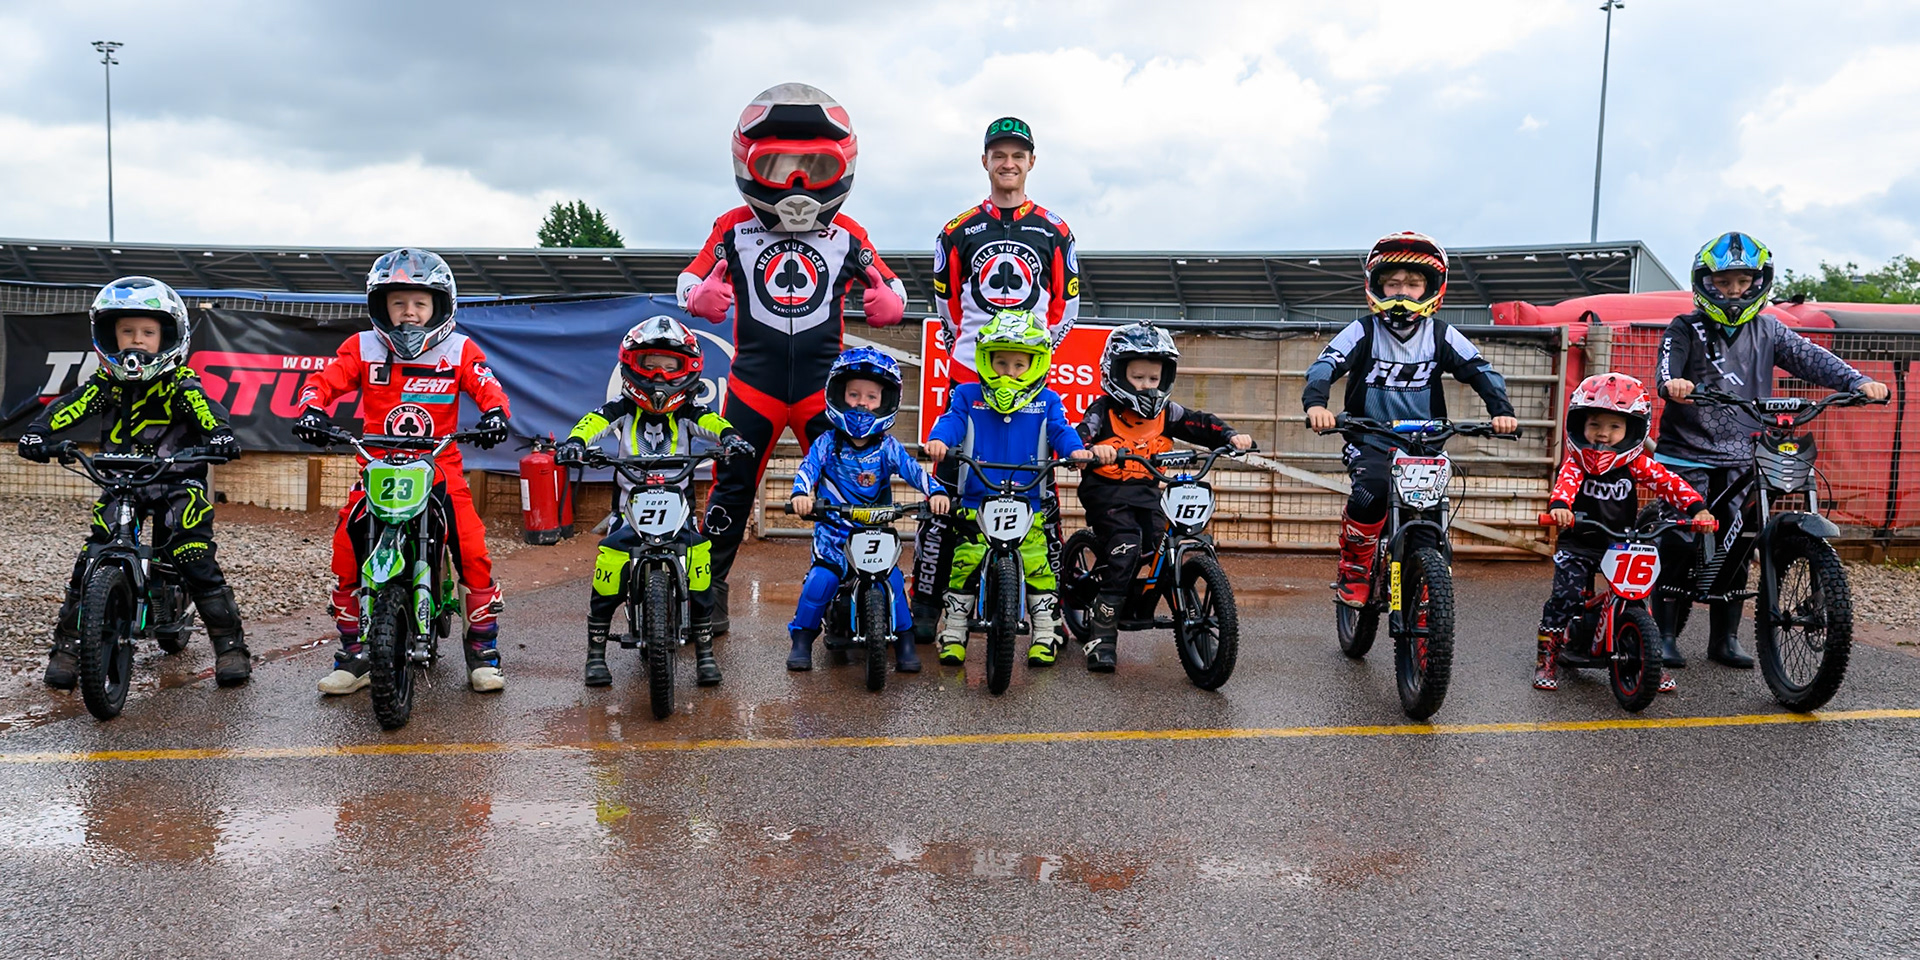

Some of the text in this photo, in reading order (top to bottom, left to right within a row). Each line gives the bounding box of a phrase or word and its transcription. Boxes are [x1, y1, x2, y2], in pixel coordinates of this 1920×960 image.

[989, 119, 1030, 137] BOLL
[756, 241, 827, 273] BELLE VUE ACES
[998, 244, 1021, 255] VUE
[772, 304, 811, 314] MANCESTER
[1364, 360, 1438, 388] FLY
[402, 377, 456, 393] LEATT
[1765, 400, 1800, 411] revvi
[1401, 464, 1439, 489] 95
[380, 477, 414, 501] 23
[1583, 478, 1633, 501] revvi
[638, 509, 668, 526] 21
[1175, 504, 1209, 519] 167
[993, 515, 1018, 532] 12
[1723, 510, 1744, 552] revvi
[173, 541, 209, 557] ASTARS
[864, 540, 881, 554] 3
[1612, 553, 1657, 586] 16
